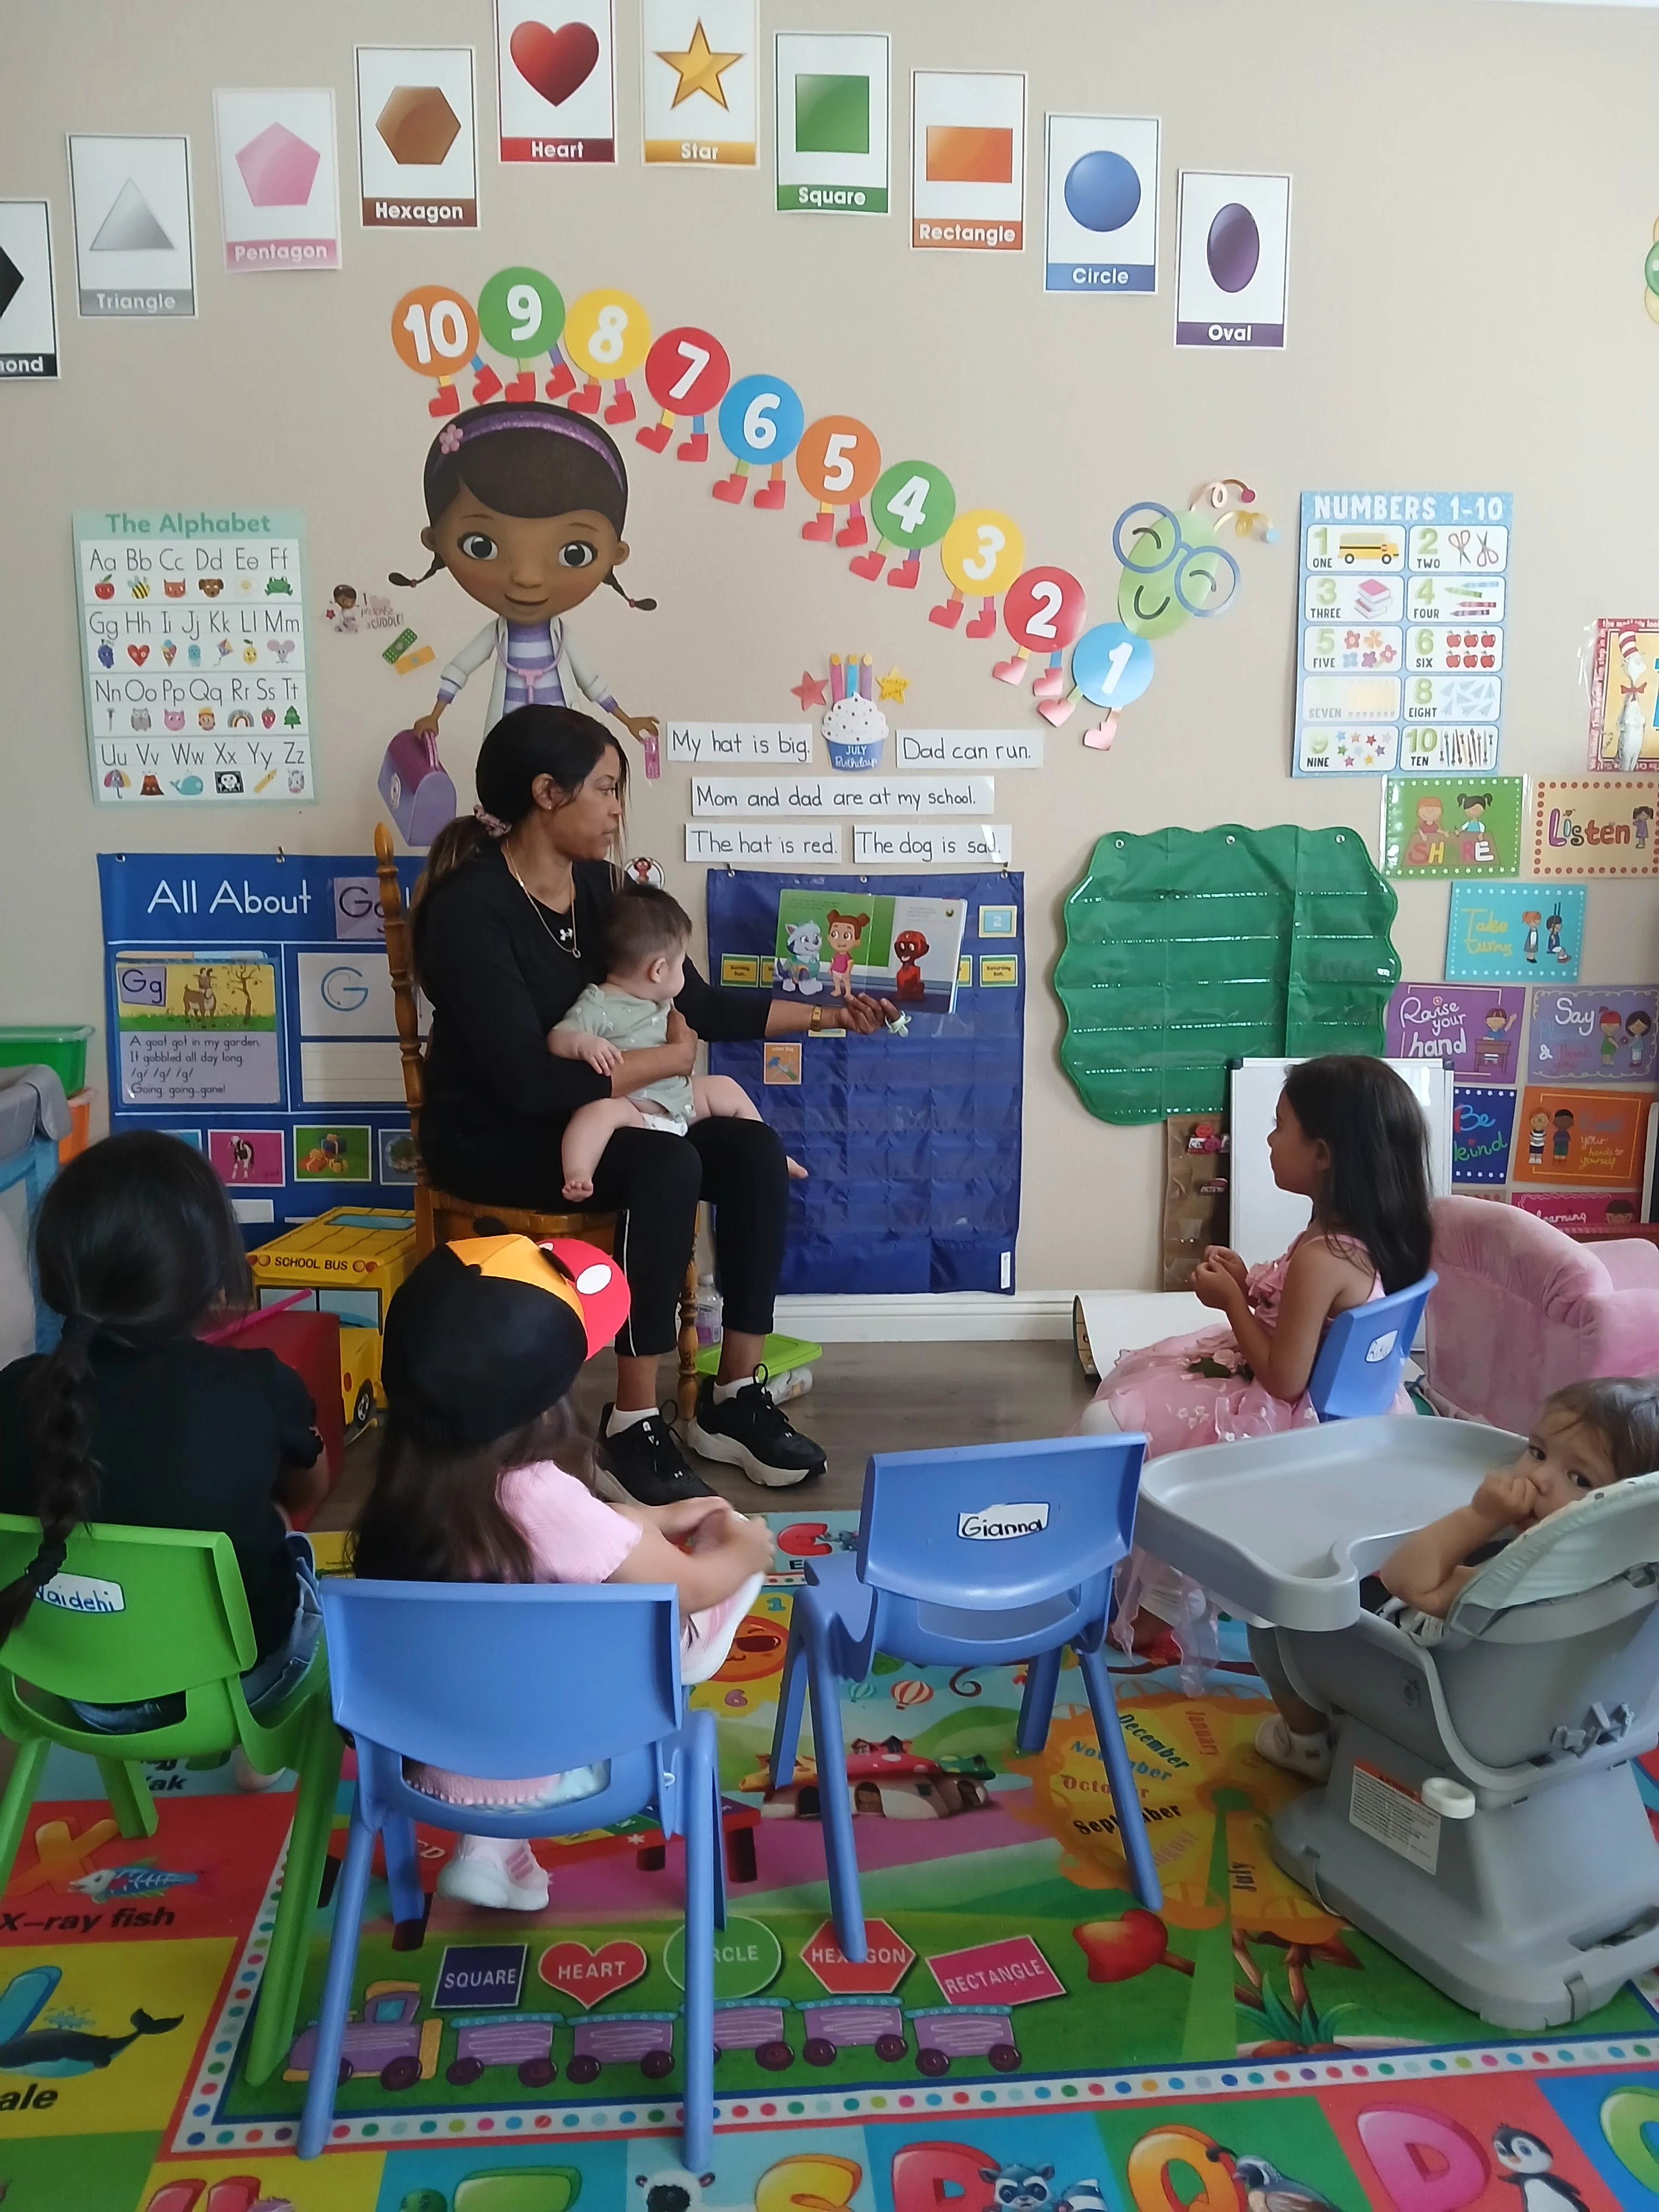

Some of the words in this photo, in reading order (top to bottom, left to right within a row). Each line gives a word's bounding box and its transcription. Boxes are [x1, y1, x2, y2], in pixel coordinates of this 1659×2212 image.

[531, 140, 584, 158] Heart
[681, 142, 718, 161] Star
[799, 187, 866, 207] Square
[375, 202, 463, 224] Hexagon
[919, 223, 1015, 247] Rectangle
[234, 244, 327, 262] Pentagon
[1072, 267, 1129, 285] Circle
[97, 293, 176, 314] Triangle
[506, 285, 542, 341] 9
[403, 300, 468, 365] 10
[588, 305, 628, 363] 8
[1208, 324, 1252, 342] Oval
[668, 340, 710, 400] 7
[743, 393, 781, 449] 6
[823, 433, 857, 492] 5
[886, 475, 930, 534] 4
[1314, 495, 1436, 521] NUMBERS
[106, 513, 150, 534] The
[159, 512, 271, 538] Alphabet
[963, 525, 1006, 581] 3
[1313, 527, 1328, 556] 1
[1418, 528, 1438, 555] 2
[89, 548, 116, 571] Aa
[127, 548, 152, 570] Bb
[159, 548, 184, 571] Cc
[196, 548, 223, 571] Dd
[236, 547, 259, 570] Ee
[270, 546, 288, 570] Ff
[1313, 558, 1333, 569] ONE
[1416, 559, 1441, 569] TWO
[1316, 578, 1337, 606] 3
[1414, 578, 1435, 606] 4
[1026, 581, 1063, 639] 2
[1310, 608, 1341, 619] THREE
[1413, 608, 1439, 619] FOUR
[89, 611, 119, 640] Gg
[125, 611, 151, 634] Hh
[162, 611, 171, 634] Ii
[182, 610, 200, 641] Jj
[209, 610, 230, 633] Kk
[241, 610, 257, 633] Ll
[265, 610, 300, 633] Mm
[1316, 628, 1335, 654] 5
[1416, 628, 1434, 655] 6
[1101, 641, 1134, 695] 1
[1313, 658, 1335, 668] FIVE
[1416, 658, 1433, 668] SIX
[95, 680, 121, 702] Nn
[125, 679, 157, 702] Oo
[163, 679, 185, 706] Pp
[189, 678, 223, 706] Qq
[232, 678, 249, 701] Rr
[256, 678, 275, 700] Ss
[282, 677, 298, 700] Tt
[1415, 678, 1433, 704] 8
[1309, 708, 1342, 718] SEVEN
[1409, 708, 1437, 718] EIGHT
[672, 730, 701, 762] My
[712, 731, 742, 753] hat
[753, 733, 769, 754] is
[779, 732, 810, 762] big.
[846, 745, 866, 755] JULY
[903, 737, 944, 760] Dad
[952, 742, 987, 760] can
[996, 742, 1031, 760] run.
[1405, 728, 1437, 753] 10
[101, 743, 127, 766] Uu
[136, 743, 159, 766] Vv
[171, 743, 204, 766] Ww
[215, 742, 237, 765] Xx
[247, 742, 273, 770] Yy
[284, 742, 305, 764] Zz
[1307, 757, 1329, 767] NINE
[1410, 756, 1429, 767] TEN
[697, 786, 738, 807] Mom
[748, 786, 779, 807] and
[788, 785, 821, 807] dad
[833, 792, 863, 806] are
[870, 786, 891, 806] at
[898, 793, 921, 811] my
[928, 784, 975, 805] school.
[1548, 808, 1630, 847] Listen
[691, 830, 732, 853] The
[739, 831, 772, 853] hat
[780, 834, 794, 854] is
[803, 831, 838, 854] red.
[856, 831, 893, 853] The
[899, 832, 933, 861] dog
[941, 833, 955, 853] is
[147, 879, 197, 915] All
[209, 879, 311, 915] About
[993, 916, 1001, 927] 2
[121, 969, 163, 1004] Gg
[321, 966, 369, 1012] G
[1400, 996, 1459, 1028] Raise
[1555, 998, 1594, 1036] Say
[1432, 1014, 1467, 1036] your
[130, 1036, 141, 1046] A
[146, 1035, 166, 1051] goat
[172, 1036, 187, 1051] got
[192, 1037, 200, 1046] in
[204, 1039, 220, 1051] my
[1409, 1028, 1467, 1057] hand
[1539, 1044, 1553, 1060] &
[144, 1051, 182, 1066] gobbled
[185, 1052, 196, 1062] all
[201, 1052, 218, 1066] day
[131, 1068, 147, 1082] /g/
[153, 1068, 171, 1082] /g/
[176, 1068, 194, 1082] /g/
[1454, 1103, 1495, 1133] Be
[1454, 1131, 1508, 1161] kind
[274, 1256, 320, 1270] SCHOOL
[325, 1259, 348, 1271] BUS
[962, 1516, 1042, 1537] Gianna
[767, 1597, 787, 1611] 1
[724, 1689, 748, 1707] 6
[1119, 1714, 1189, 1768] December
[1071, 1741, 1172, 1781] Nober
[146, 1774, 187, 1791] ak
[1061, 1774, 1149, 1799] Octor
[1073, 1805, 1181, 1835] Sepber
[111, 1907, 175, 1928] fish
[813, 1949, 905, 1964] HEXGON
[445, 1969, 516, 1989] SQUARE
[558, 1962, 626, 1980] HEART
[944, 1959, 1044, 1994] RECTANGLE
